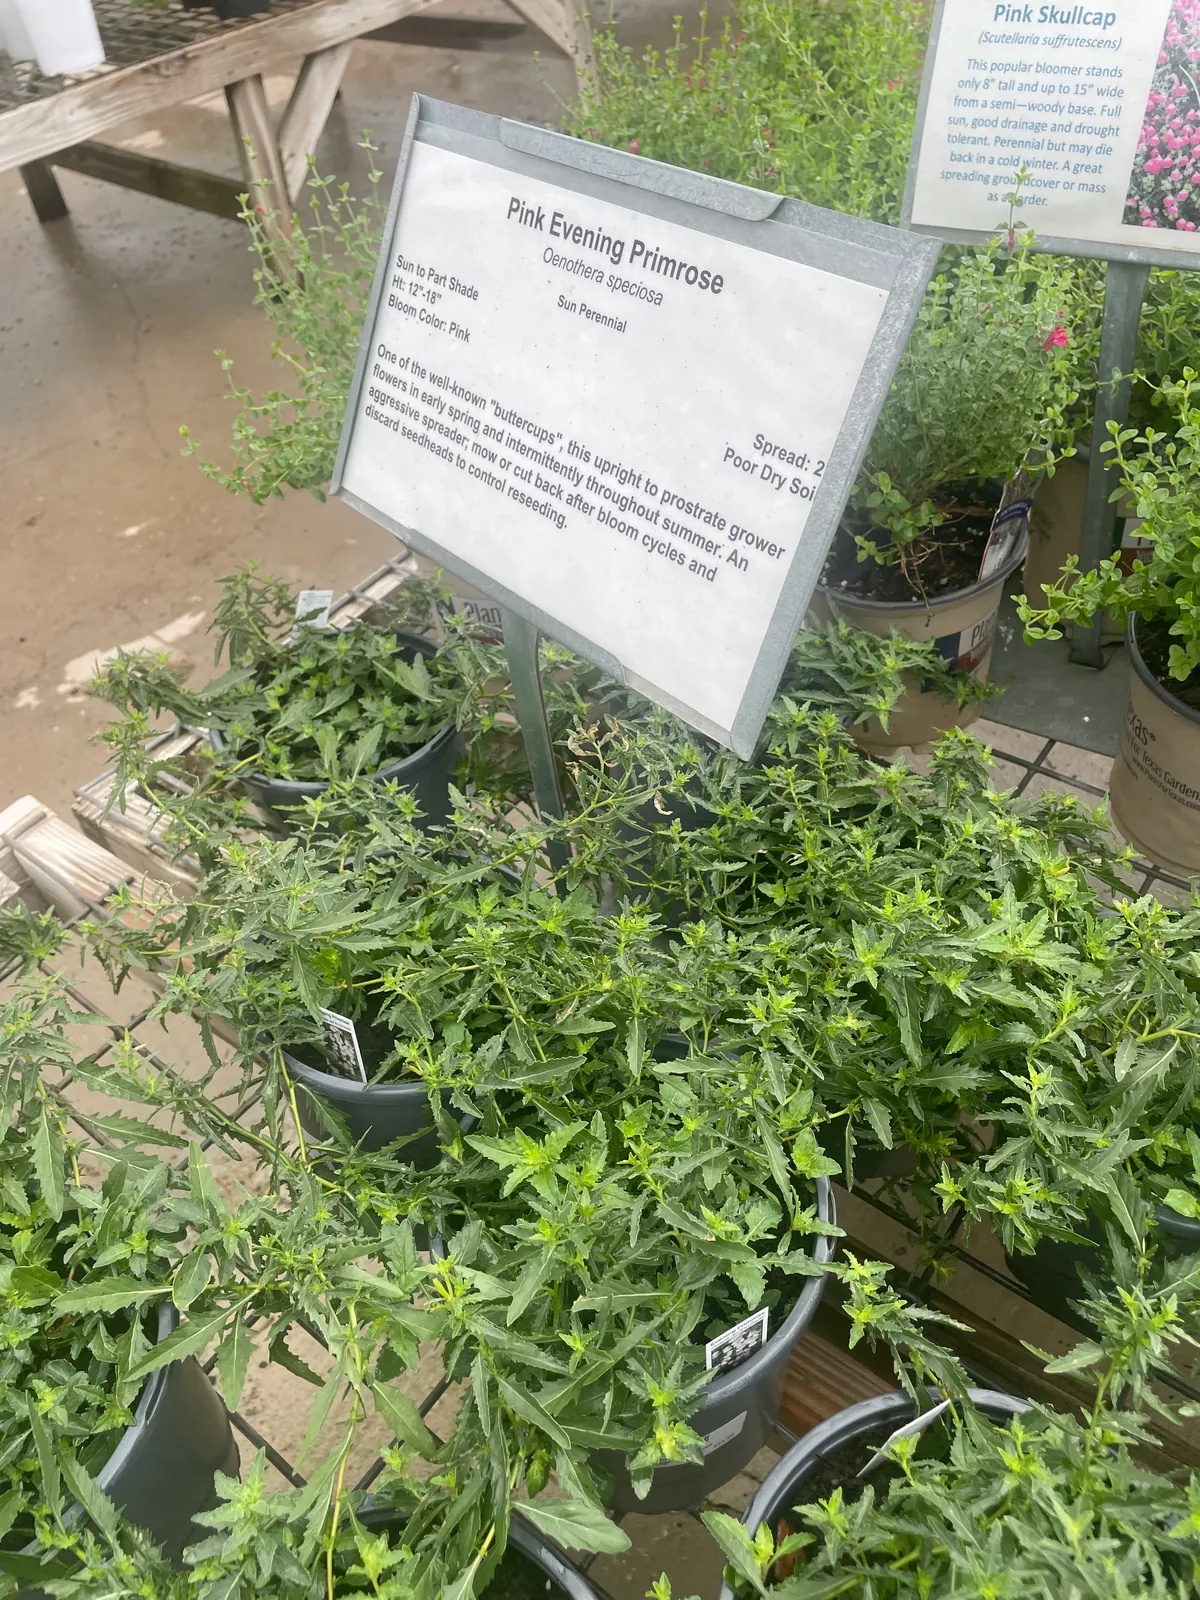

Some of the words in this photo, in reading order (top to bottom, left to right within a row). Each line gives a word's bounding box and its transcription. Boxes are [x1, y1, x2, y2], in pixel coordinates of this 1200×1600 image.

[993, 4, 1032, 23] Pink
[1037, 5, 1116, 30] Skullcap
[978, 30, 1040, 46] (Scutellaria
[1041, 34, 1122, 52] suffrutescens)
[966, 58, 988, 71] This
[990, 60, 1032, 78] popular
[1036, 61, 1083, 76] bloomer
[1085, 64, 1123, 78] stands
[958, 77, 980, 92] only
[998, 78, 1015, 92] tall
[1017, 80, 1038, 92] and
[1040, 83, 1055, 96] up
[1058, 82, 1070, 94] to
[1096, 86, 1124, 98] wide
[954, 96, 979, 108] from
[981, 100, 988, 108] a
[1067, 102, 1096, 116] base.
[1100, 104, 1122, 118] Full
[948, 116, 969, 128] sun,
[971, 115, 998, 130] good
[1001, 116, 1048, 135] drainage
[1050, 118, 1072, 133] and
[1074, 121, 1120, 138] drought
[947, 132, 990, 147] tolerant.
[994, 137, 1044, 152] Perennial
[1047, 138, 1065, 152] but
[1068, 143, 1093, 157] may
[1096, 141, 1113, 156] die
[950, 150, 974, 164] back
[976, 152, 986, 164] in
[988, 156, 995, 166] a
[998, 153, 1020, 167] cold
[1022, 157, 1060, 170] winter.
[1062, 160, 1070, 172] A
[1073, 162, 1102, 176] great
[940, 170, 990, 186] spreading
[1062, 180, 1075, 190] or
[1078, 182, 1106, 194] mass
[987, 192, 998, 202] as
[1001, 194, 1008, 202] a
[507, 197, 546, 231] Pink
[549, 212, 625, 265] Evening
[629, 239, 724, 294] Primrose
[392, 274, 406, 291] Ht:
[408, 282, 442, 304] 12"-18"
[396, 255, 414, 272] Sun
[416, 264, 426, 278] to
[427, 268, 447, 288] Part
[448, 277, 478, 300] Shade
[543, 248, 604, 284] Oenothera
[606, 272, 664, 306] speciosa
[388, 294, 416, 318] Bloom
[419, 309, 447, 332] Color:
[448, 322, 471, 343] Pink
[557, 294, 576, 313] Sun
[578, 303, 628, 334] Perennial
[365, 404, 400, 432] discard
[400, 424, 454, 463] seedheads
[456, 454, 466, 470] to
[468, 463, 507, 493] control
[507, 484, 568, 530] reseeding.
[378, 344, 397, 364] One
[399, 357, 411, 369] of
[411, 361, 426, 378] the
[429, 372, 487, 410] well-known
[490, 399, 564, 452] "buttercups",
[567, 440, 591, 463] this
[594, 456, 642, 490] upright
[644, 478, 658, 496] to
[660, 490, 727, 531] prostrate
[728, 524, 786, 560] grower
[753, 434, 810, 471] Spread:
[372, 364, 407, 392] flowers
[410, 383, 419, 398] in
[421, 392, 446, 414] early
[448, 406, 481, 434] spring
[482, 424, 504, 444] and
[506, 432, 584, 488] intermittently
[586, 475, 660, 526] throughout
[662, 517, 723, 558] summer.
[726, 549, 750, 572] An
[723, 447, 758, 474] Poor
[760, 464, 788, 490] Dry
[368, 386, 420, 421] aggressive
[422, 414, 470, 451] spreader;
[472, 439, 498, 464] mow
[499, 458, 512, 471] or
[514, 465, 533, 484] cut
[534, 475, 564, 502] back
[566, 492, 596, 517] after
[597, 506, 640, 541] bloom
[642, 532, 686, 566] cycles
[688, 558, 718, 582] and
[1164, 771, 1200, 801] Garden
